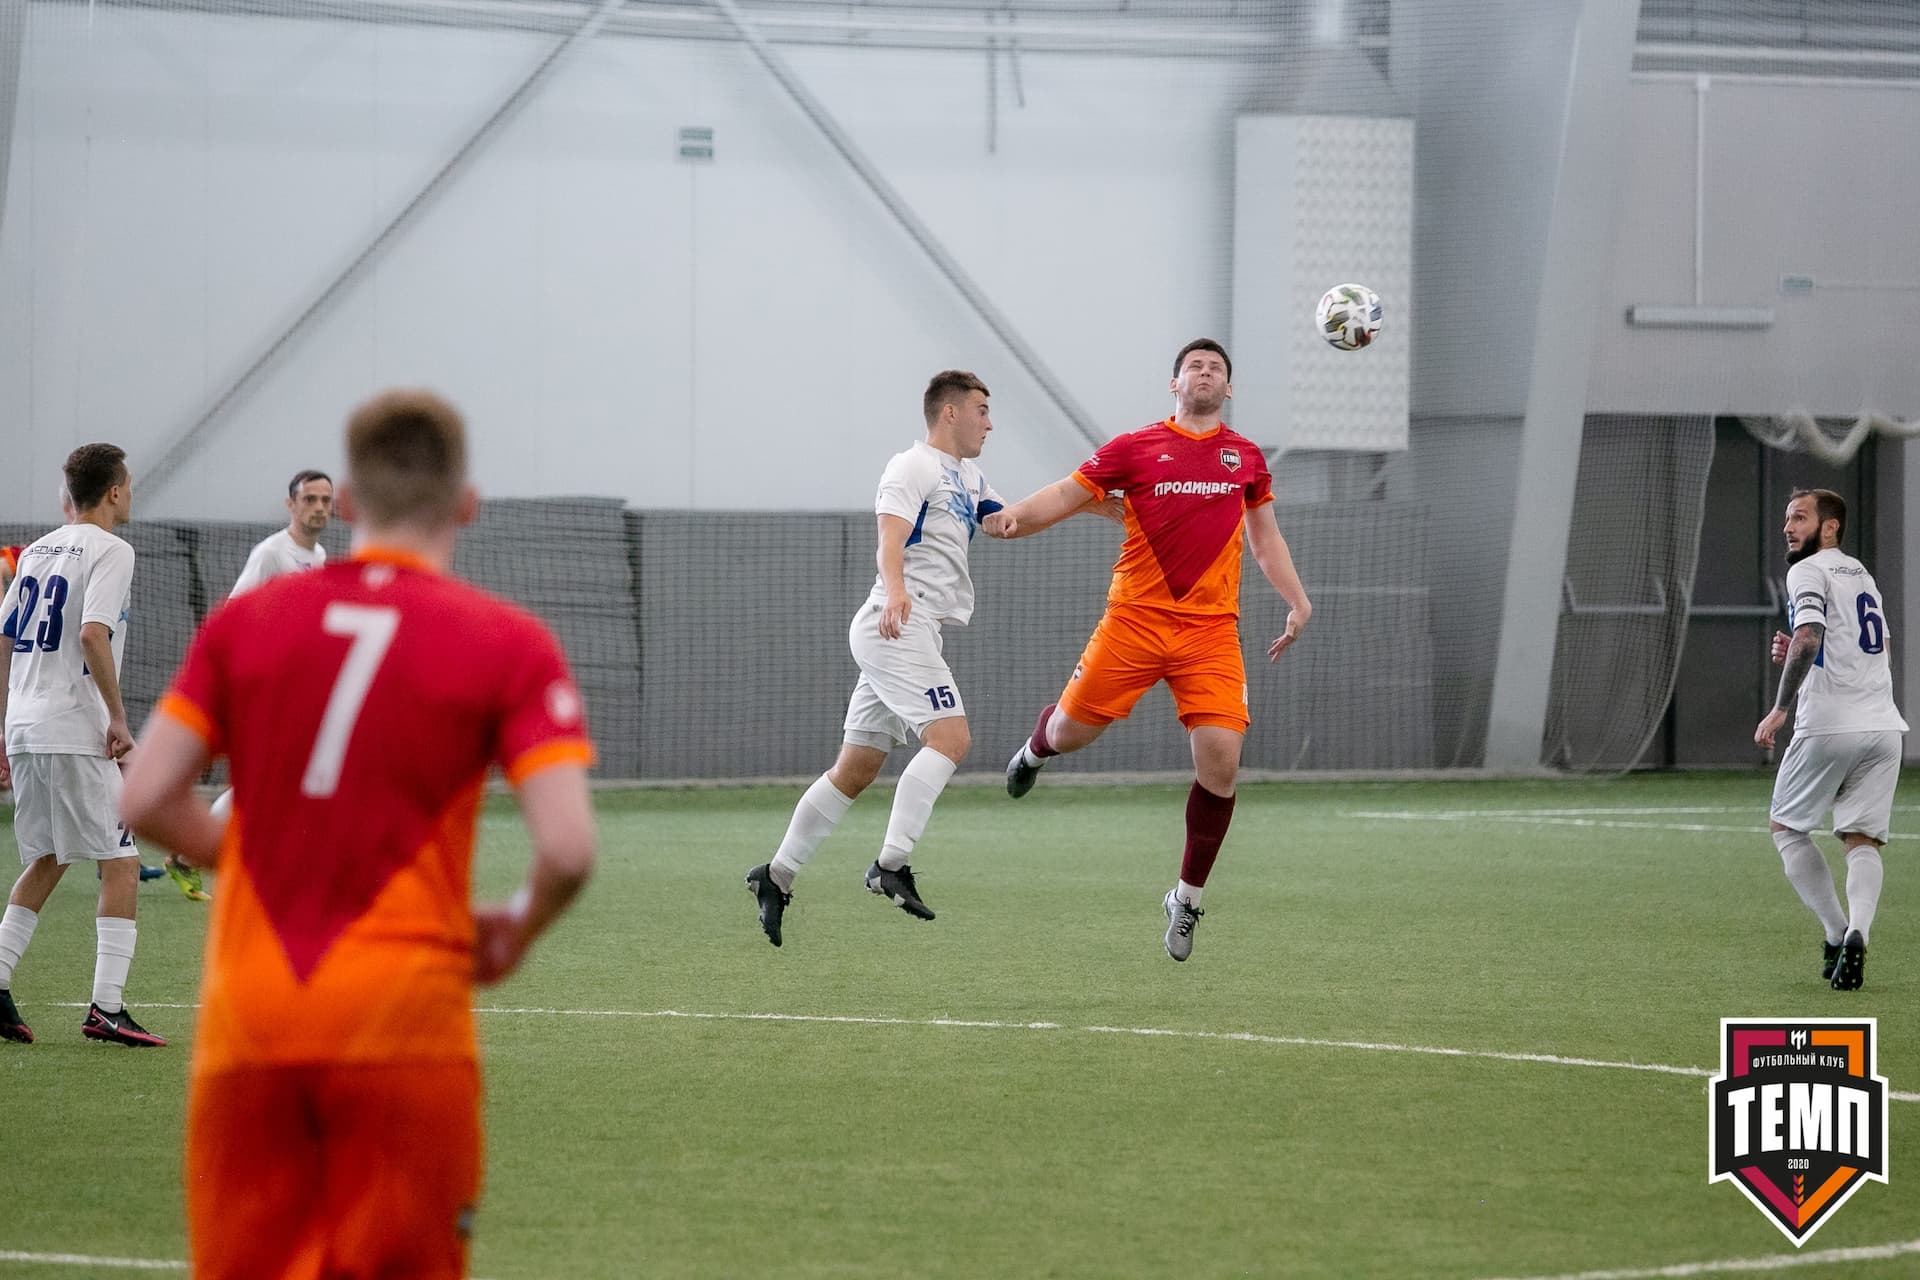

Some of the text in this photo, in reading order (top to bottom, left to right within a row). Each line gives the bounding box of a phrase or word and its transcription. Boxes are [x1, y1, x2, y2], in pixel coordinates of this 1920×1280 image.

[13, 574, 69, 652] 23
[1856, 591, 1884, 655] 6
[301, 600, 401, 800] 7
[924, 685, 956, 711] 15
